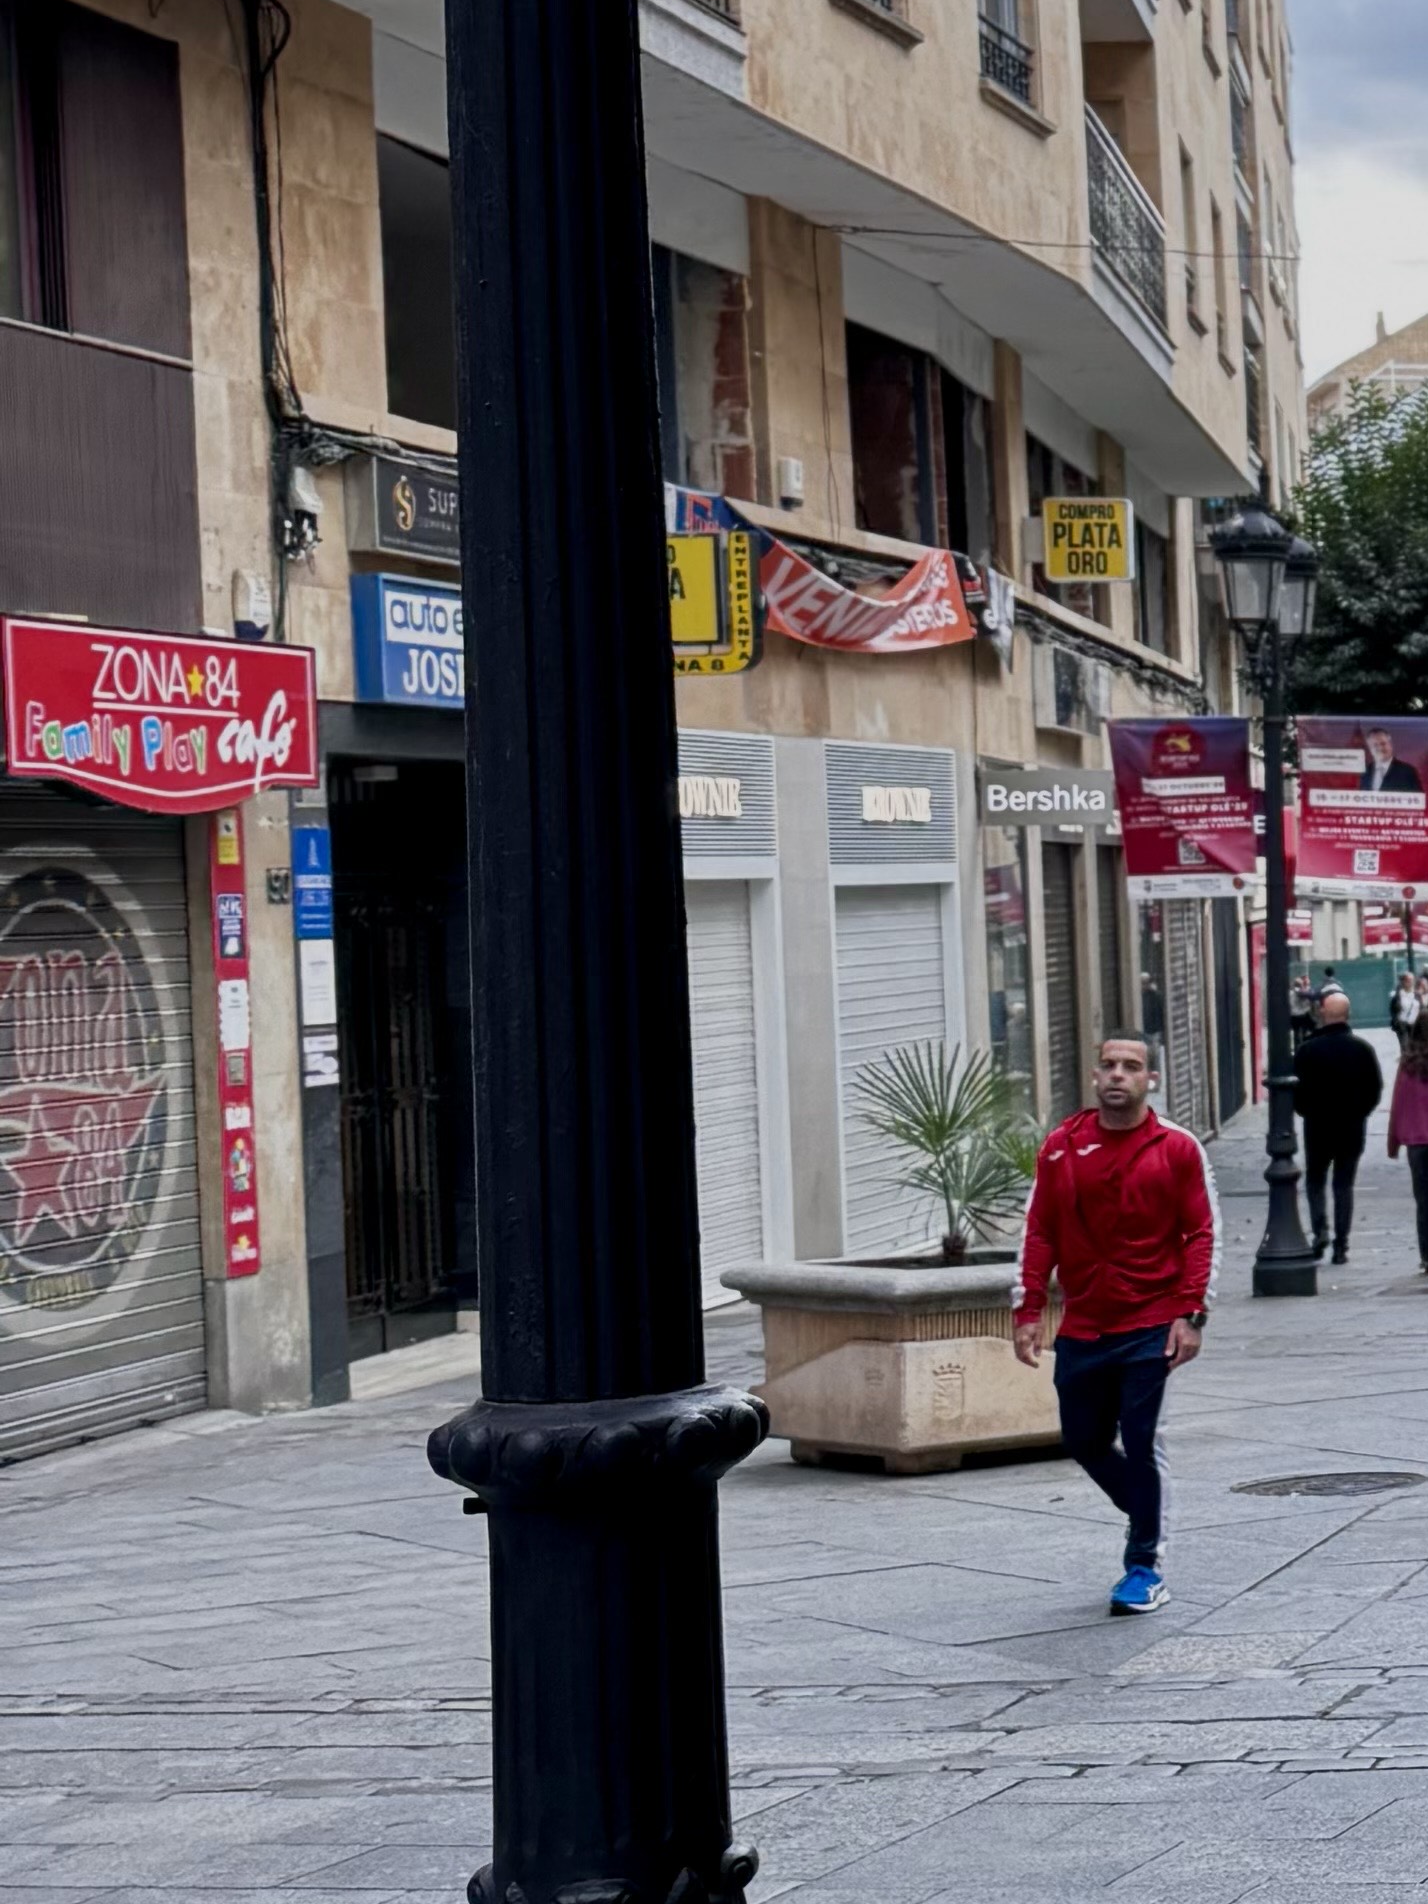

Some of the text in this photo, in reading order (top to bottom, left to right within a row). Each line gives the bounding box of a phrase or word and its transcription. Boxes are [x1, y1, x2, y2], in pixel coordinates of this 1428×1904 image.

[1058, 503, 1116, 520] COMPRO
[1053, 522, 1122, 549] PLATA
[1067, 551, 1108, 574] ORO
[734, 533, 750, 662] ENTREPLANTA
[390, 597, 448, 635] auto
[91, 643, 241, 708] ZONA 84
[26, 700, 131, 776] Family
[141, 715, 207, 775] Play
[987, 783, 1106, 812] Bershka
